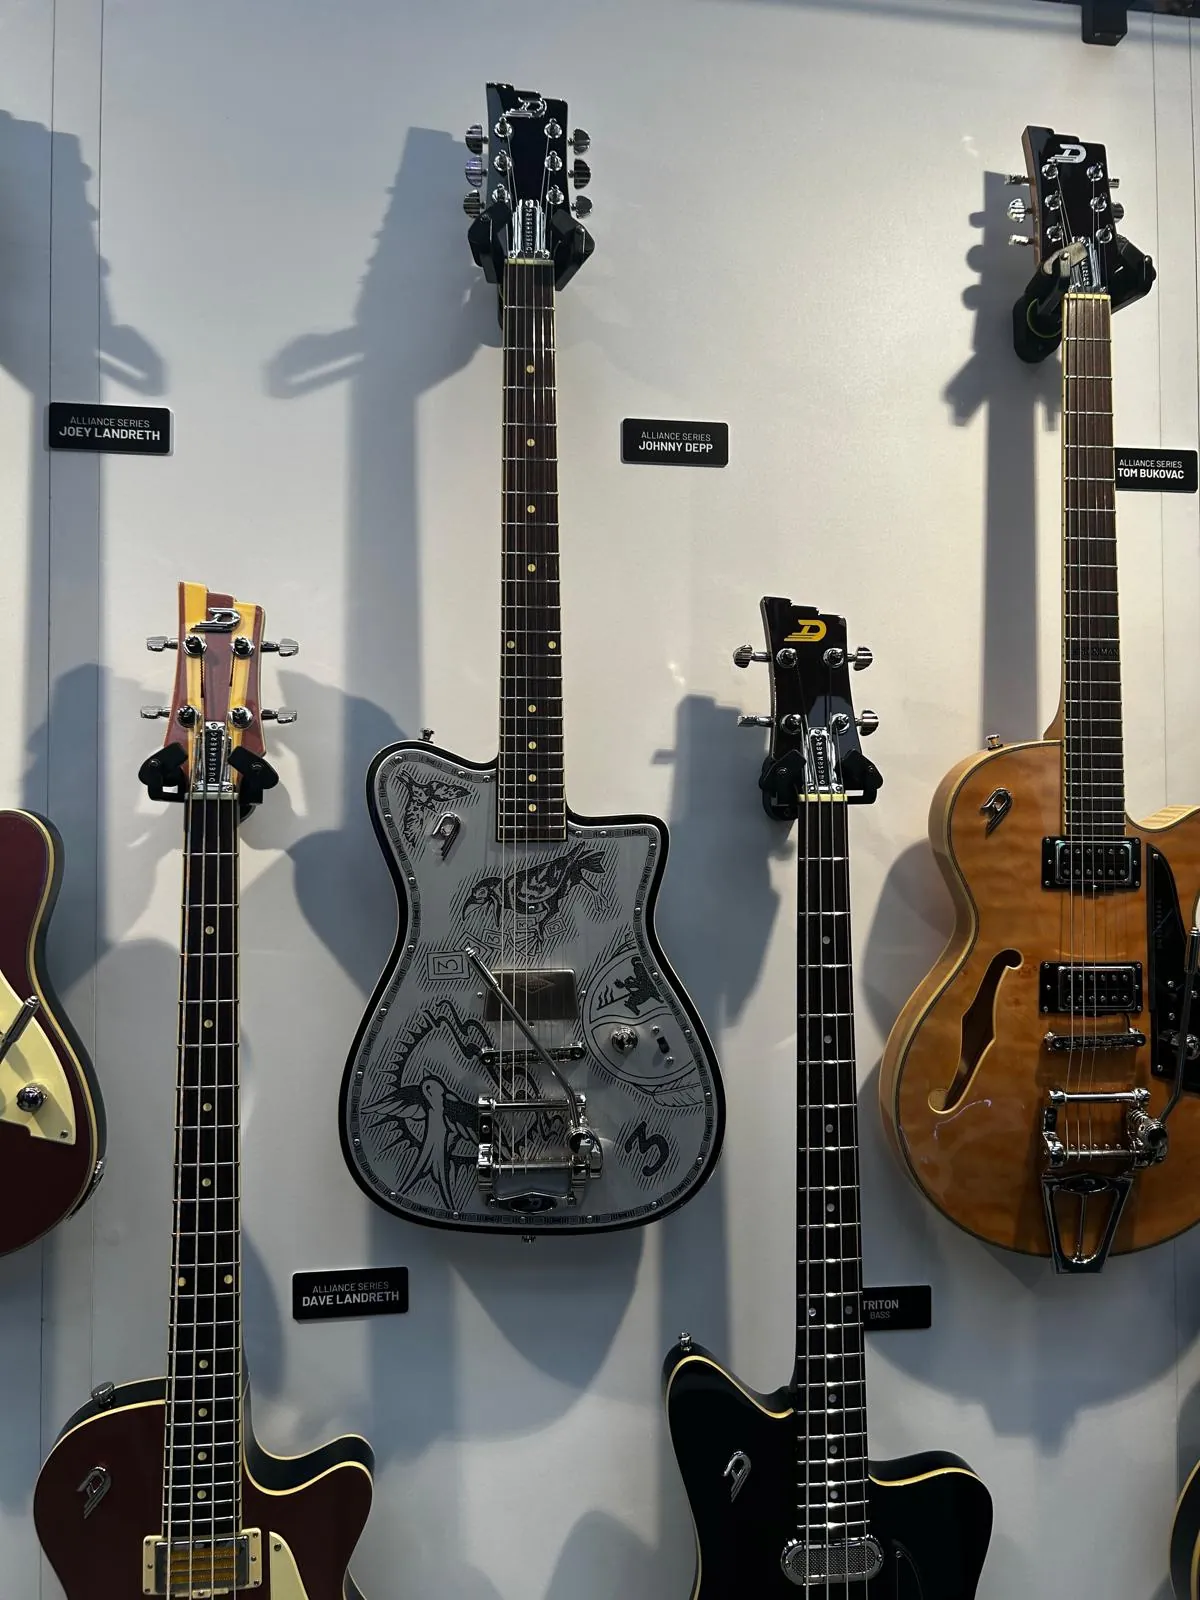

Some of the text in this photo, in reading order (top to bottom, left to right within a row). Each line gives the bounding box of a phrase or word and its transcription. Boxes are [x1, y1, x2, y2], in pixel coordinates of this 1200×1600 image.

[70, 416, 150, 428] ALLIANCE SERIES
[59, 426, 161, 441] JOEY LANDRETH
[641, 431, 711, 442] ALLIANCE SERIES
[638, 440, 713, 453] JOHNNY DEPP
[1119, 459, 1183, 469] ALLIANCE SERIES
[1117, 467, 1185, 479] TOM BUKOVAC
[208, 731, 218, 783] DUESENBERG
[437, 959, 459, 972] 3
[625, 1121, 670, 1177] 3
[312, 1281, 389, 1294] ALLIANCE SERIES
[302, 1290, 400, 1307] DAVE LANDRETH
[863, 1298, 899, 1311] TRITON
[870, 1310, 891, 1320] BASS
